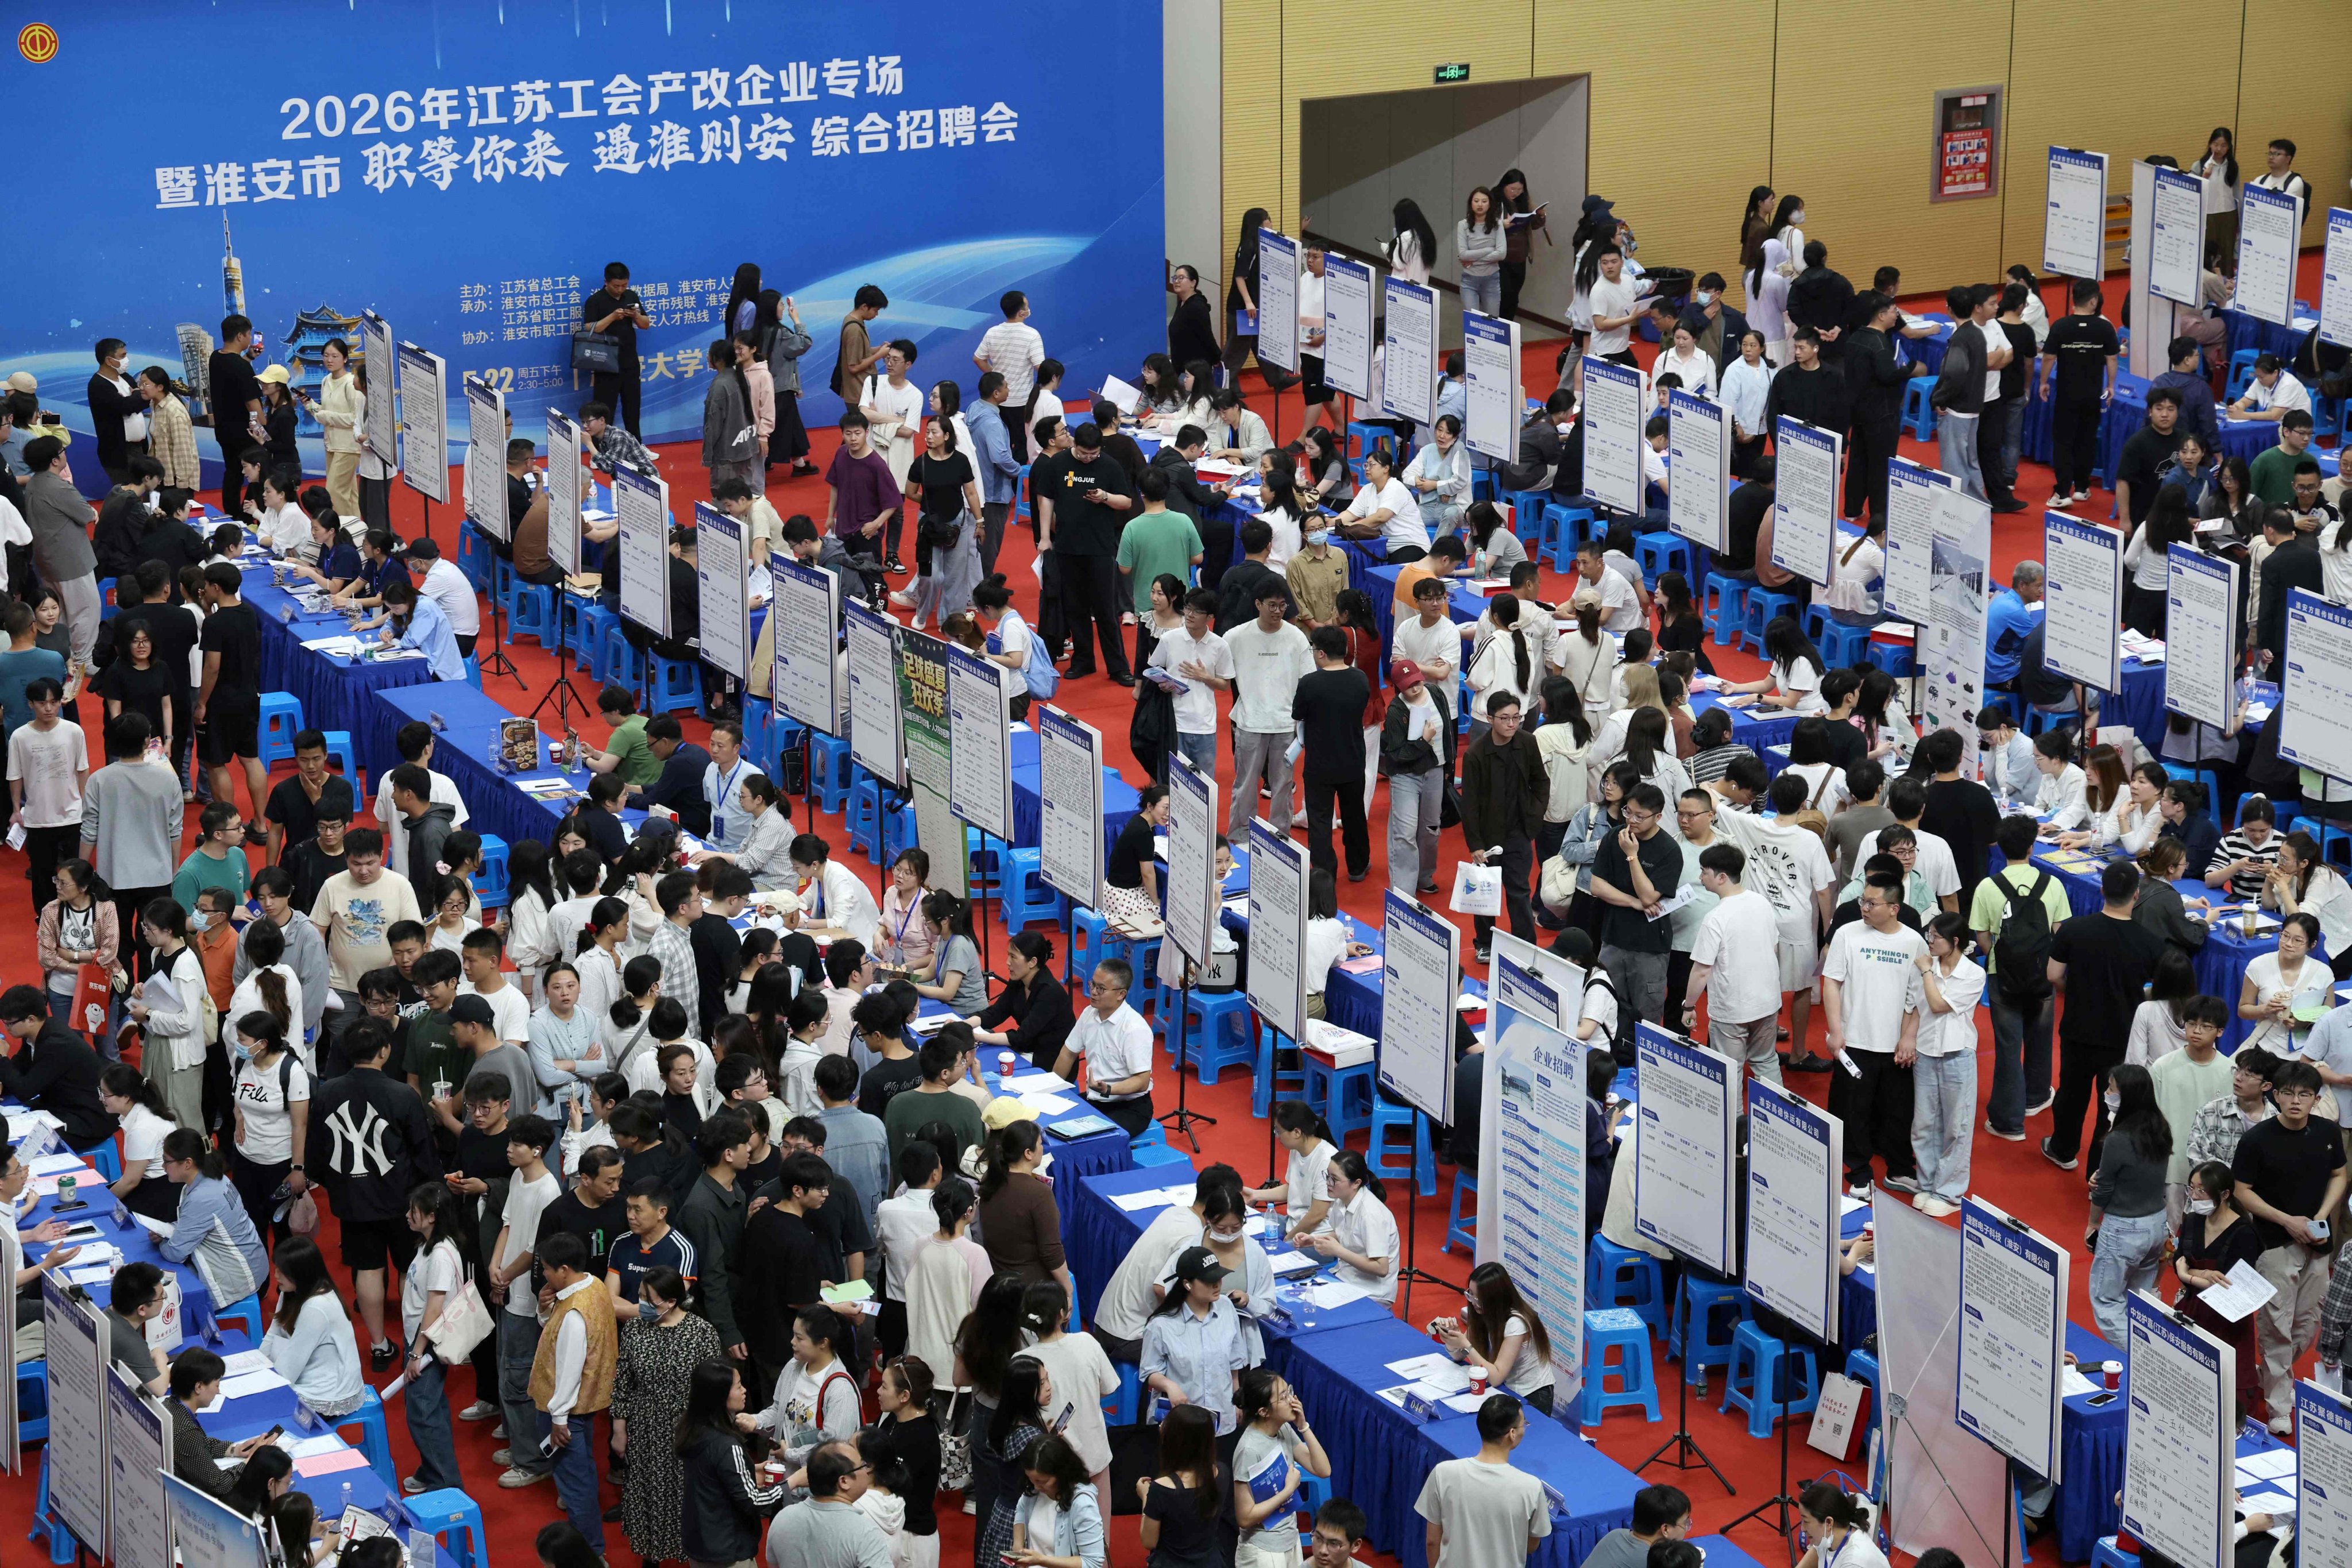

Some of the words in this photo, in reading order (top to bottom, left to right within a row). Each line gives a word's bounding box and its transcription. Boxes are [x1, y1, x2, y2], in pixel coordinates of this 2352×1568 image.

[280, 55, 903, 140] 2026年江苏工会产改企业专场
[155, 155, 341, 209] 暨淮安市
[361, 129, 570, 194] 职等你来
[593, 114, 795, 174] 遇淮则安
[811, 102, 1019, 158] 综合招聘会
[502, 306, 585, 326] 江苏省职工服
[518, 365, 562, 379] 周五下午
[1064, 476, 1095, 484] PANGJUE
[2050, 521, 2111, 548] 江苏淮阴正大有限公司
[902, 650, 947, 693] 足球盛夏
[910, 678, 944, 717] 狂欢季
[1773, 902, 1790, 910] NATURE
[1860, 947, 1901, 958] ANYTHING
[1533, 1046, 1574, 1080] 企业招聘
[1639, 1036, 1722, 1083] 江苏红视光电科技有限公司
[240, 1083, 268, 1103] Fila
[1759, 1095, 1819, 1139] 淮安高德快运有限公司
[1965, 1213, 2050, 1271] 捷群电子科技（淮安）有限公司
[1269, 1312, 1284, 1323] 047
[2130, 1307, 2217, 1372] 中龙护嘉(江苏)保安服务有限公司
[1410, 1400, 1424, 1414] 046
[2245, 1426, 2257, 1438] 77
[2304, 1418, 2320, 1430] 公司简介
